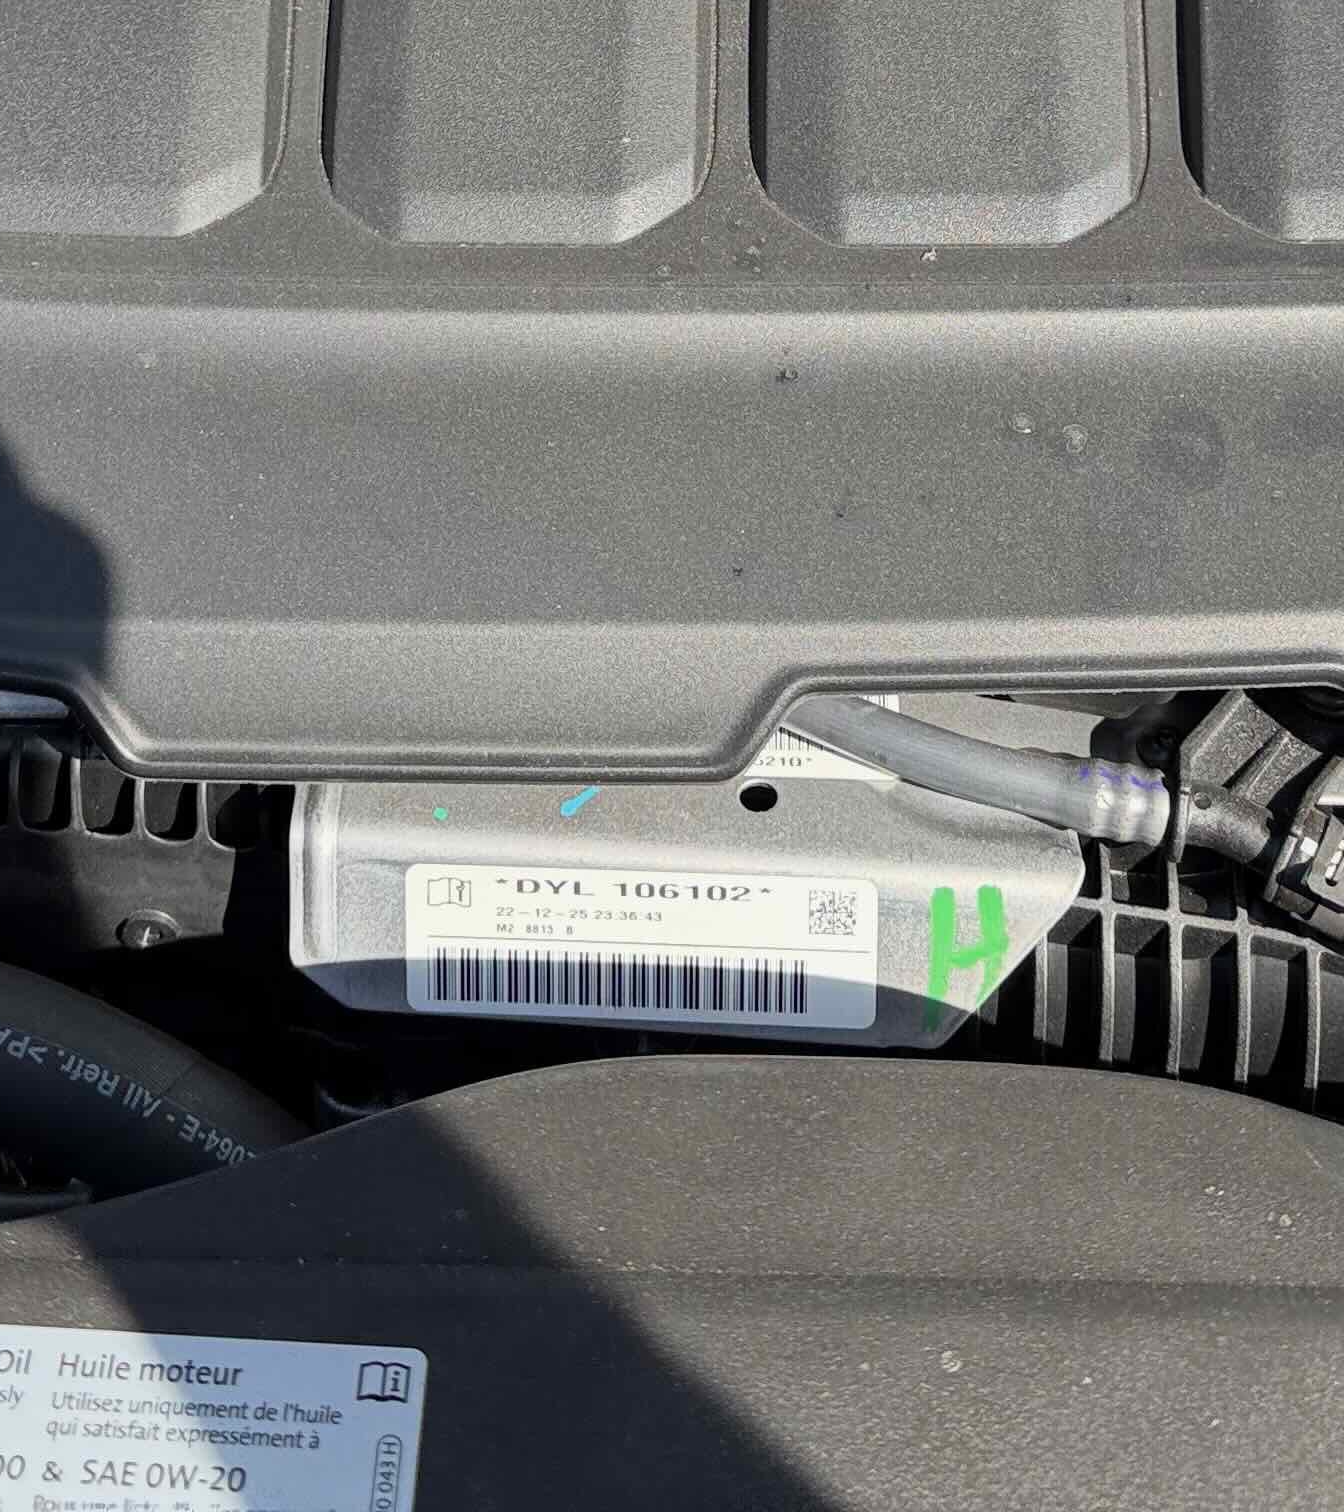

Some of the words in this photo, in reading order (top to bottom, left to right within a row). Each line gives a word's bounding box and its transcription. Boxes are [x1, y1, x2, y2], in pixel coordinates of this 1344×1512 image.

[178, 1113, 256, 1167] 064-E
[58, 1351, 131, 1380] Huile
[140, 1359, 243, 1387] moteur
[51, 1392, 125, 1413] Utilisez
[128, 1397, 249, 1422] uniquement
[253, 1401, 278, 1420] de
[283, 1402, 343, 1426] l'huile
[45, 1418, 78, 1440] qui
[82, 1419, 160, 1441] satisfait
[165, 1424, 303, 1451] expressément
[307, 1430, 320, 1449] à
[41, 1460, 64, 1483] &
[79, 1458, 138, 1487] SAE
[145, 1462, 247, 1493] 0W-20
